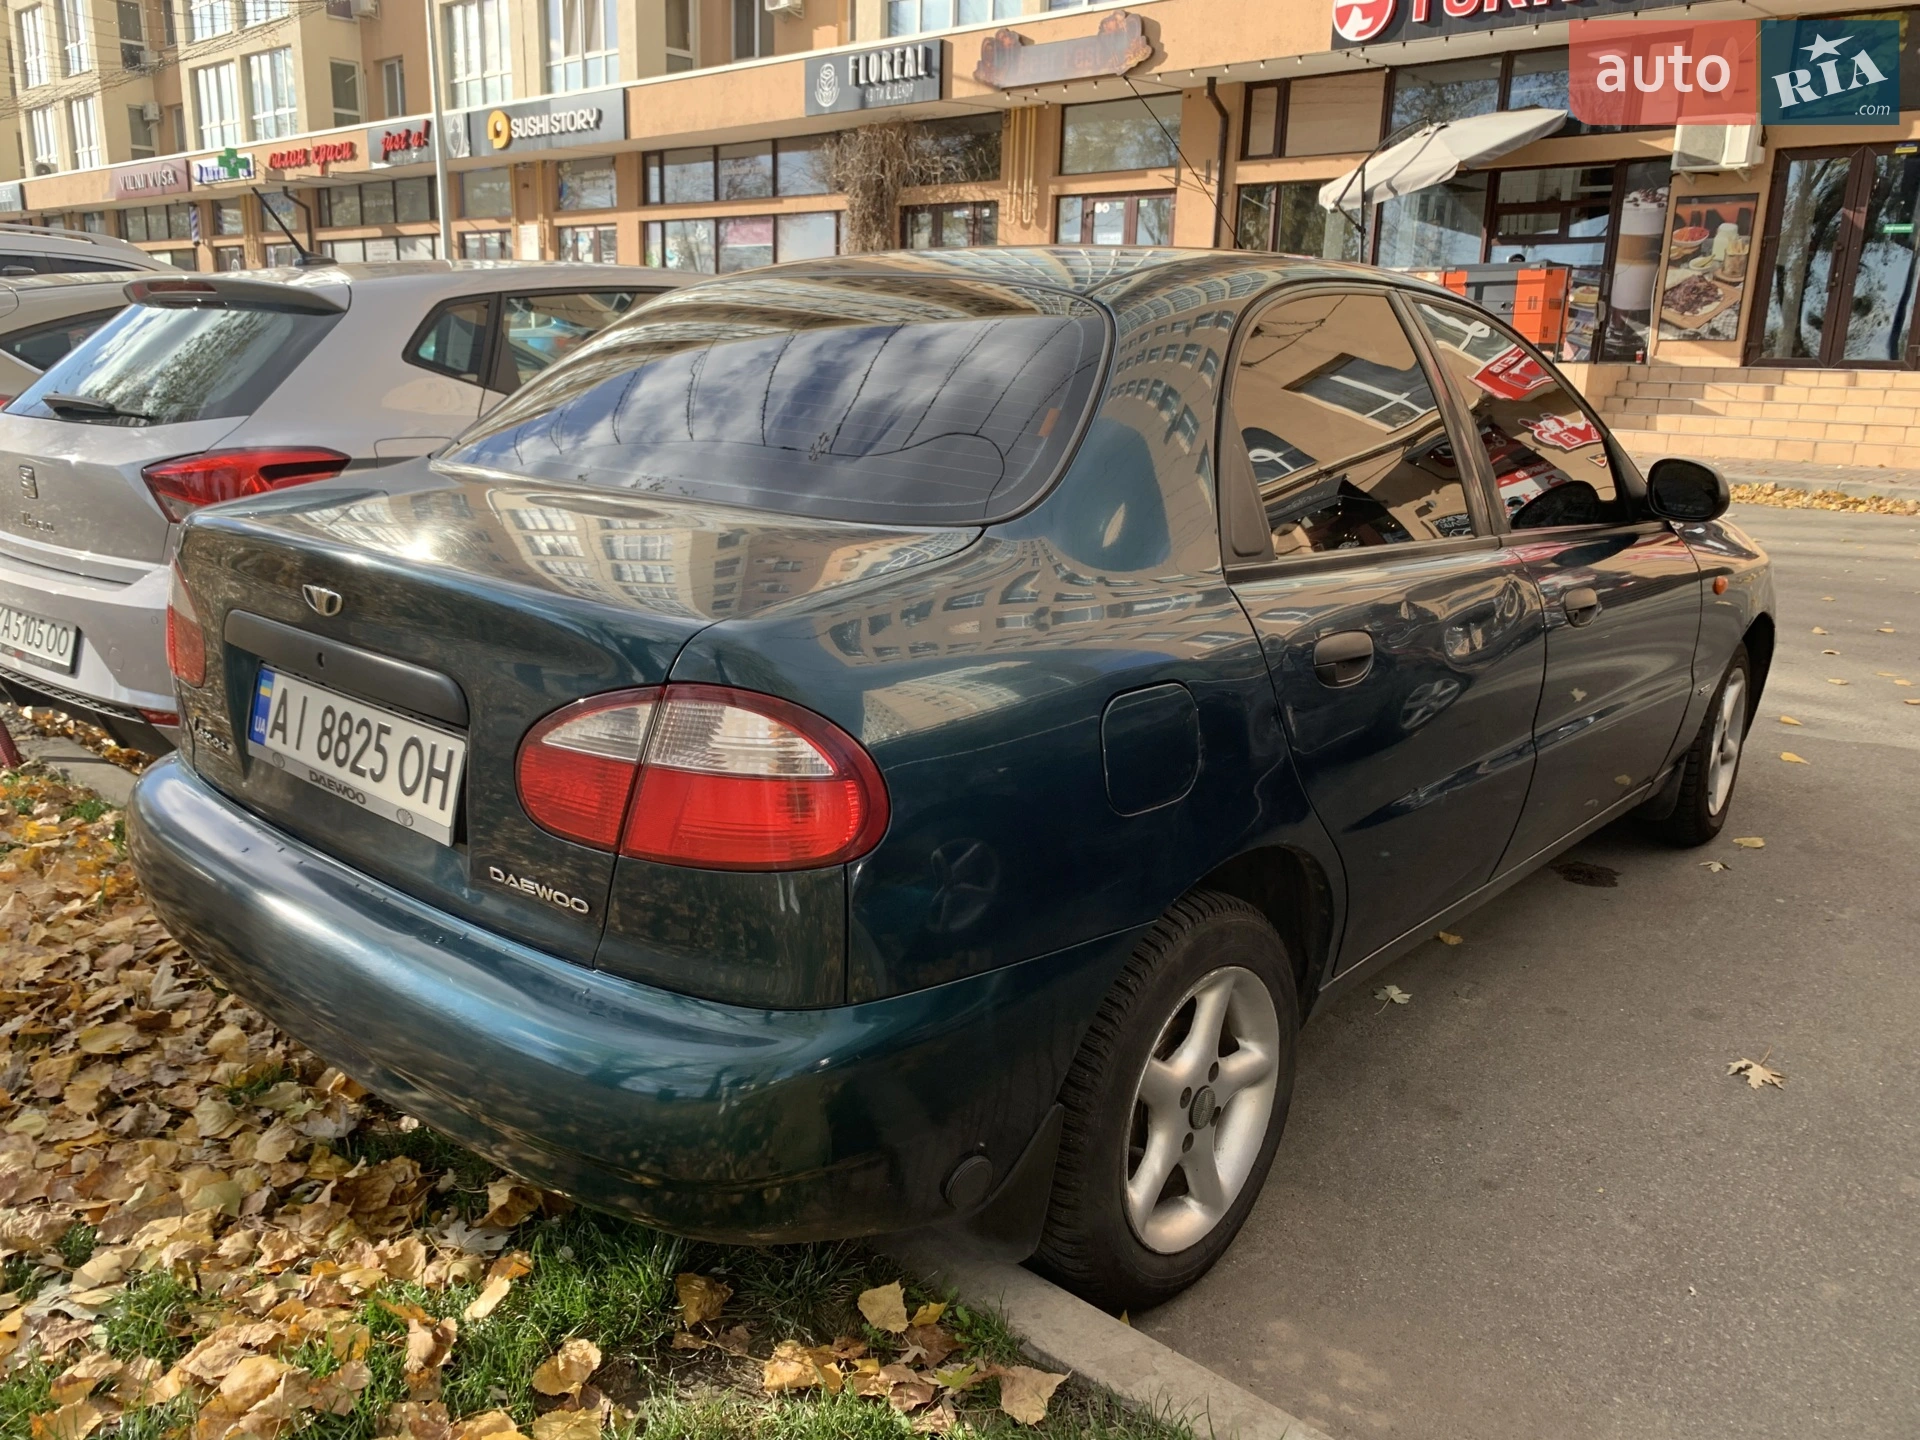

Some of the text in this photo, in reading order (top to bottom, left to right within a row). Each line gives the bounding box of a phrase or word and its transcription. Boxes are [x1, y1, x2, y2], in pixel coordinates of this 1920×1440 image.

[848, 44, 928, 86] FLOREAL
[510, 107, 597, 139] SUSHI STORY
[13, 612, 45, 649] 5105
[254, 717, 266, 735] UA
[269, 688, 455, 811] AI 8825 OH
[309, 770, 366, 805] DAEWOO
[489, 866, 590, 915] DAEWOO
